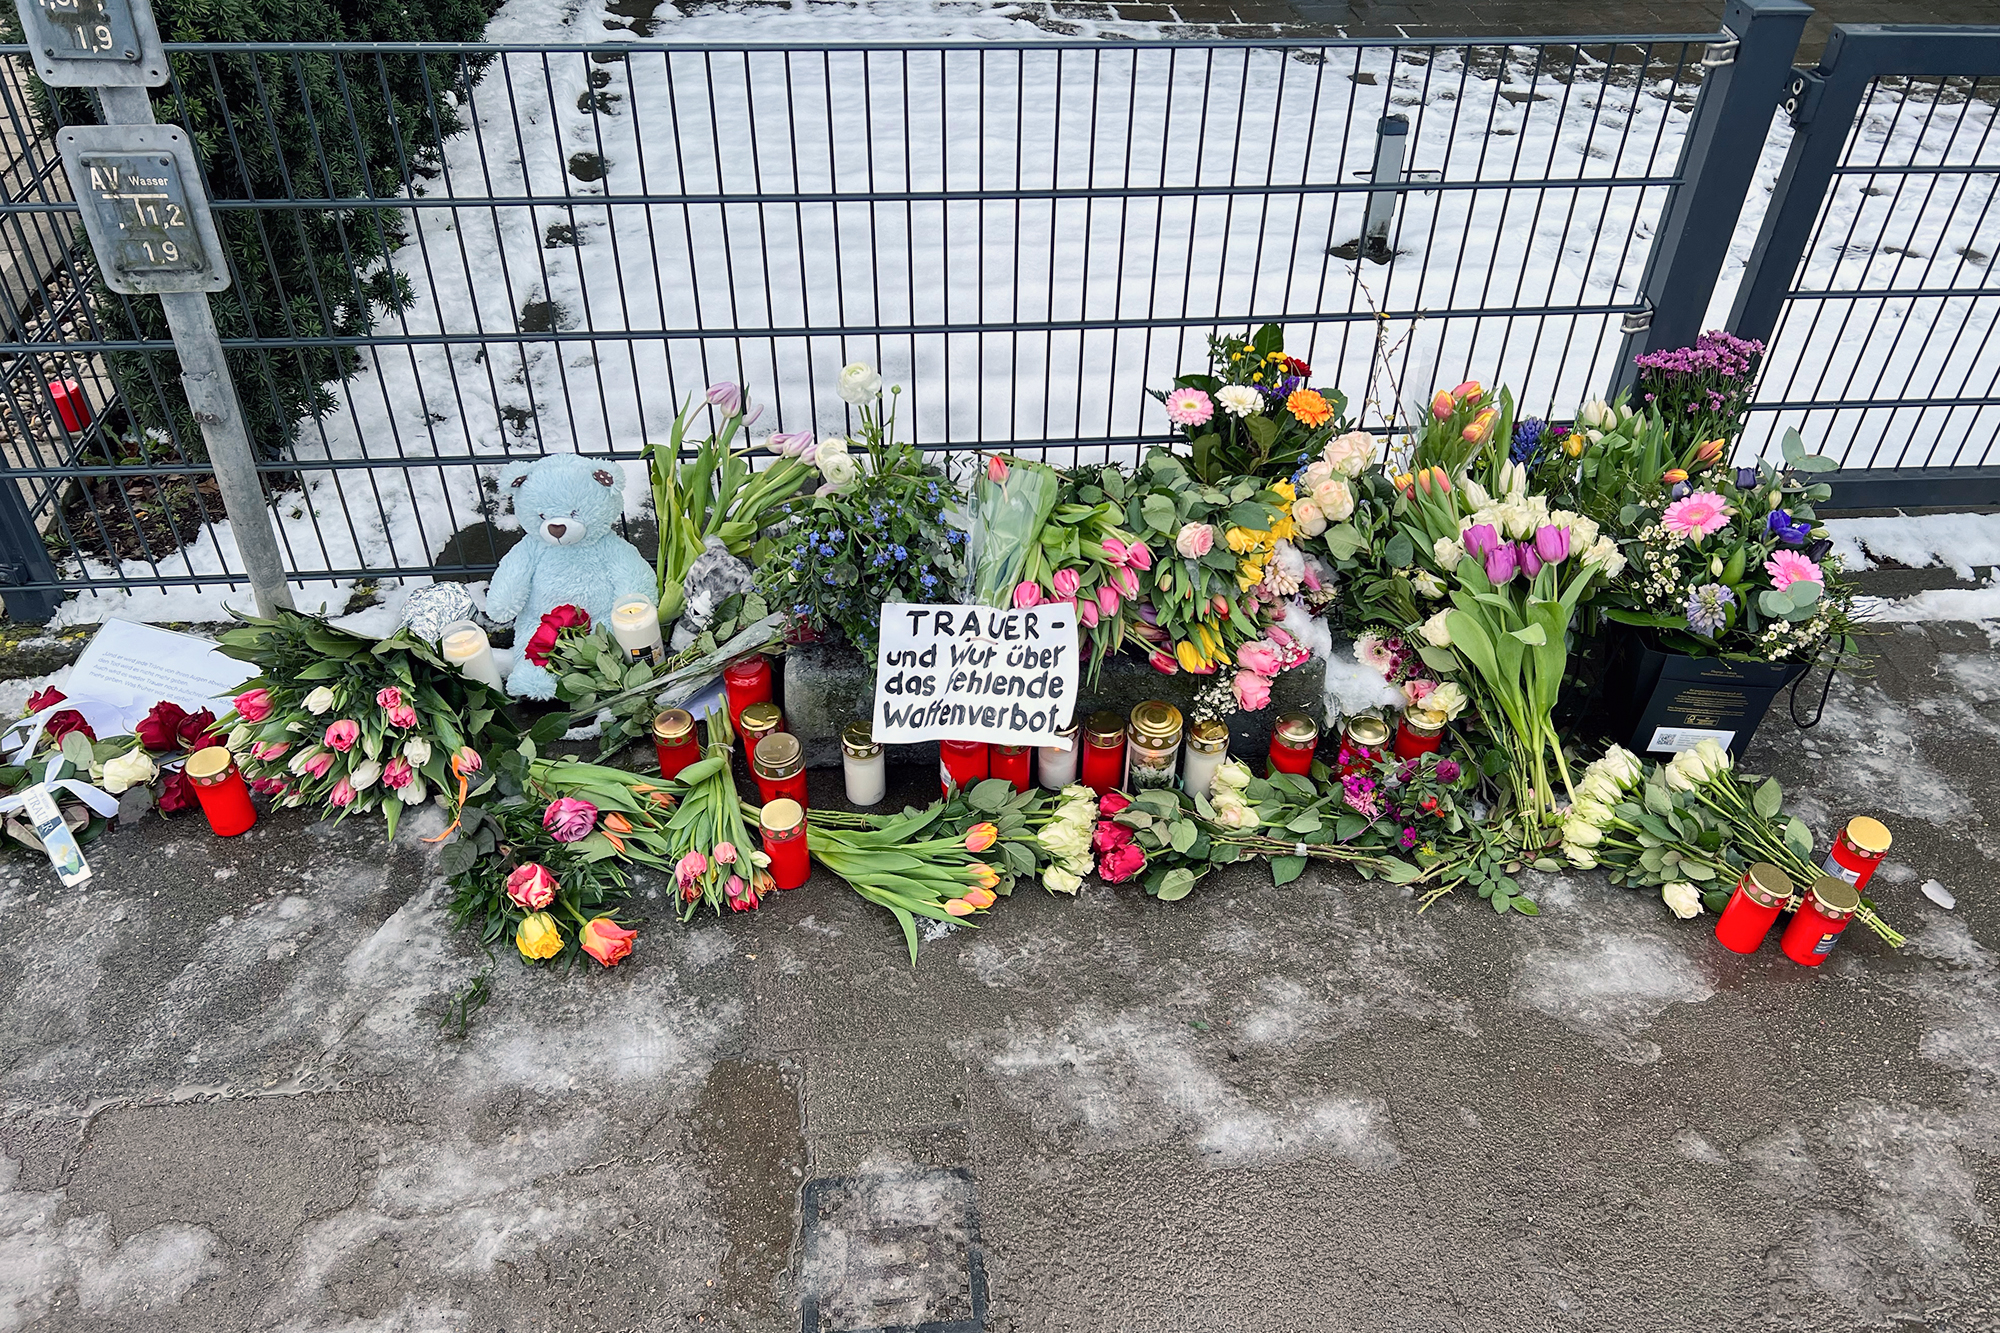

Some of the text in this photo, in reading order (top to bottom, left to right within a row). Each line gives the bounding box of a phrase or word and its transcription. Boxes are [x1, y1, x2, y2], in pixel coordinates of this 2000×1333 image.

[90, 166, 169, 191] AV Wasser
[886, 643, 1067, 669] und Wut über
[119, 663, 133, 671] wird
[139, 669, 154, 677] nicht
[154, 673, 170, 681] mehr
[124, 680, 136, 688] Was
[128, 674, 145, 682] weder
[146, 678, 164, 687] Trauer
[134, 658, 148, 667] jede
[175, 670, 189, 678] ihren
[189, 674, 208, 682] Augen
[207, 679, 231, 689] abwisch
[884, 667, 1064, 699] das fehlende
[883, 699, 1060, 734] Waffenverbot
[28, 793, 53, 833] TRAUER
